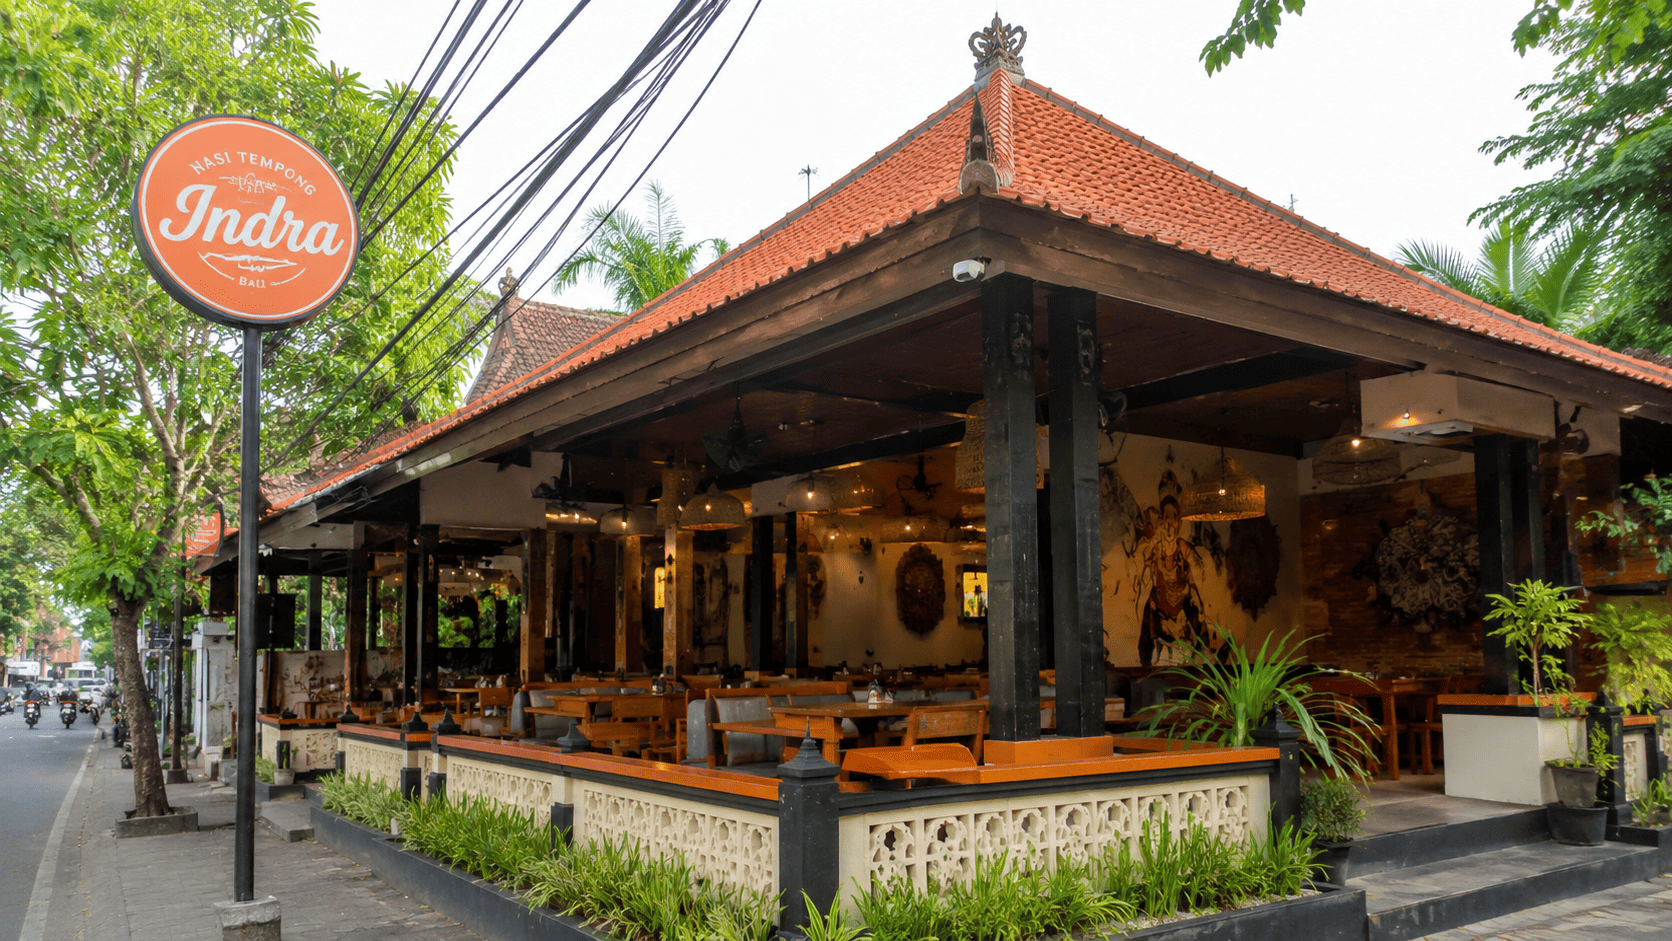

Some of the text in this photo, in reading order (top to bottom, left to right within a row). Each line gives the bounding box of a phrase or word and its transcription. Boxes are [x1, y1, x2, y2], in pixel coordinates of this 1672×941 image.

[189, 151, 316, 196] NASI TEMPONG
[159, 183, 345, 256] Indra
